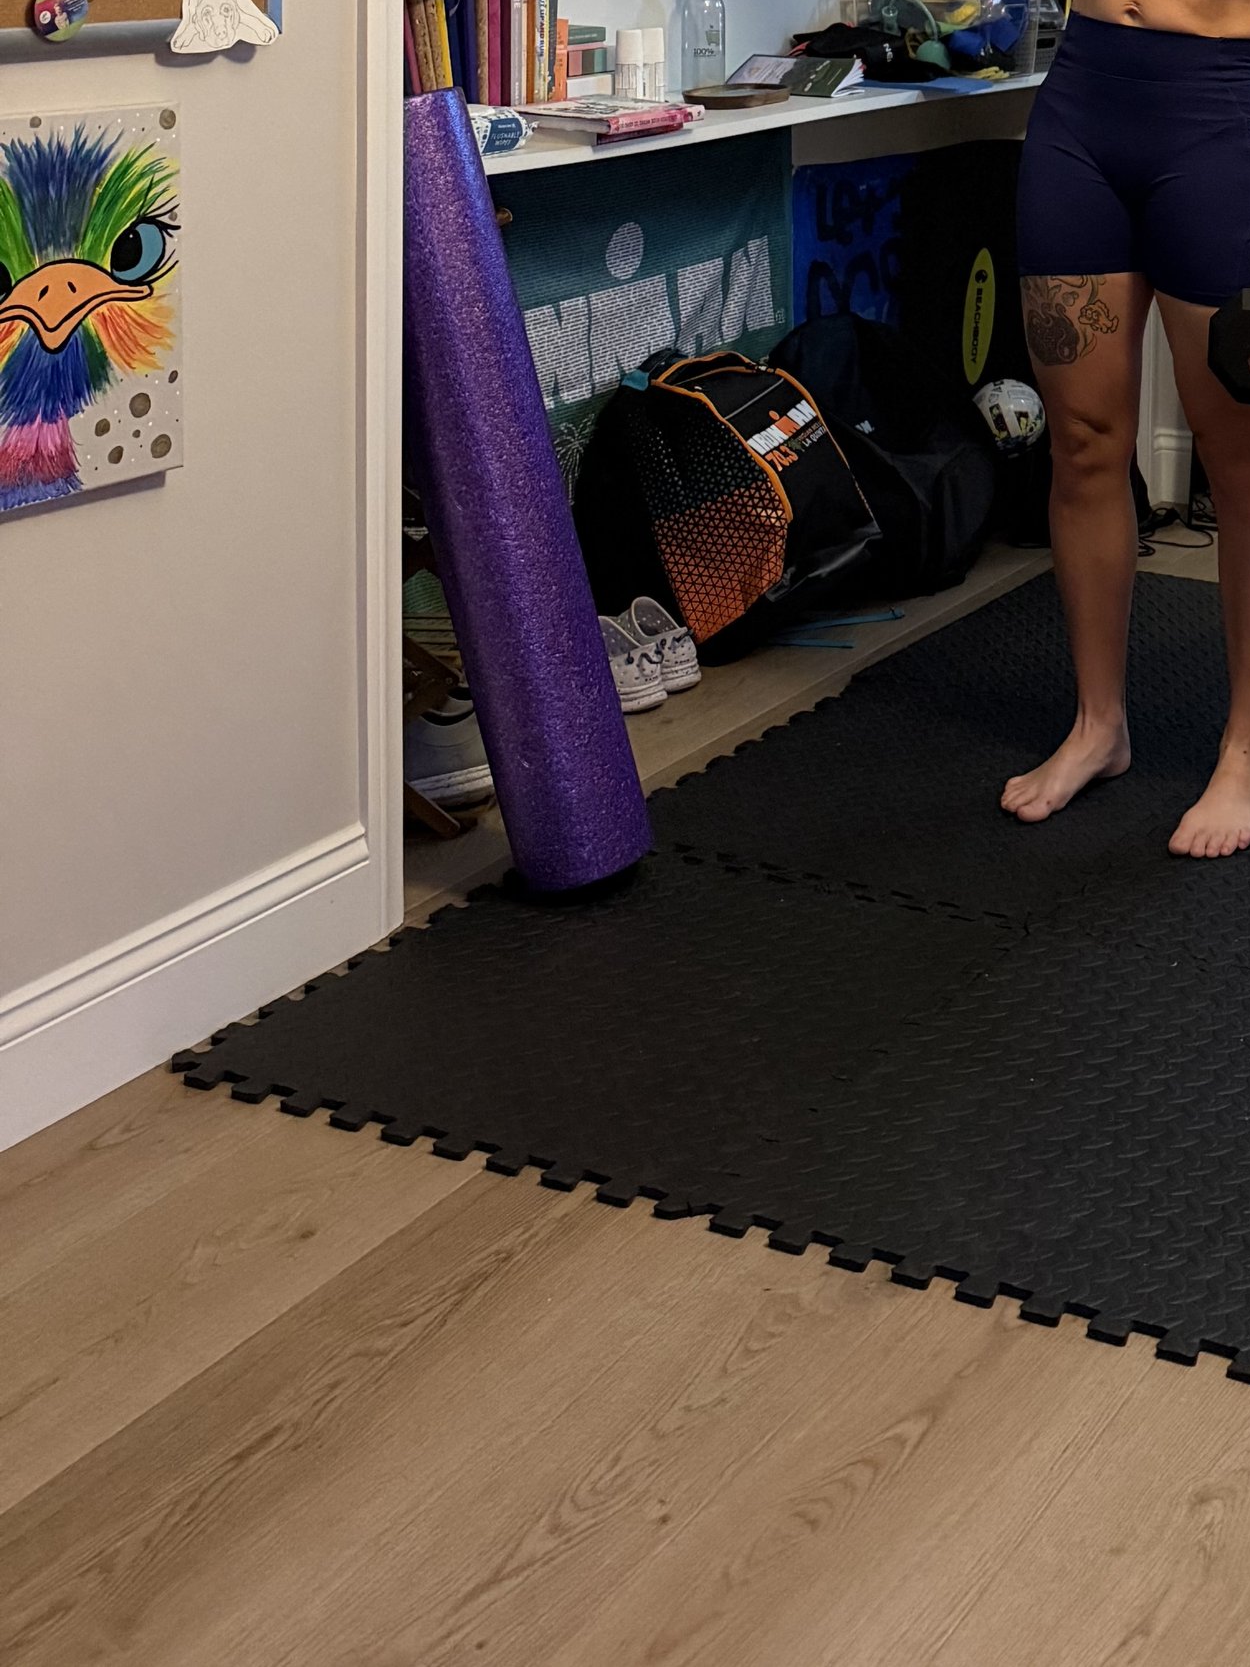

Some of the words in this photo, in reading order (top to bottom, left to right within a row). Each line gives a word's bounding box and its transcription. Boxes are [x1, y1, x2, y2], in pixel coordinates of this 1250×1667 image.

[538, 22, 547, 39] AND
[538, 40, 546, 58] RUN
[972, 287, 984, 364] BEACHBODY
[746, 399, 818, 456] IRONMAN
[764, 444, 799, 472] 70.3
